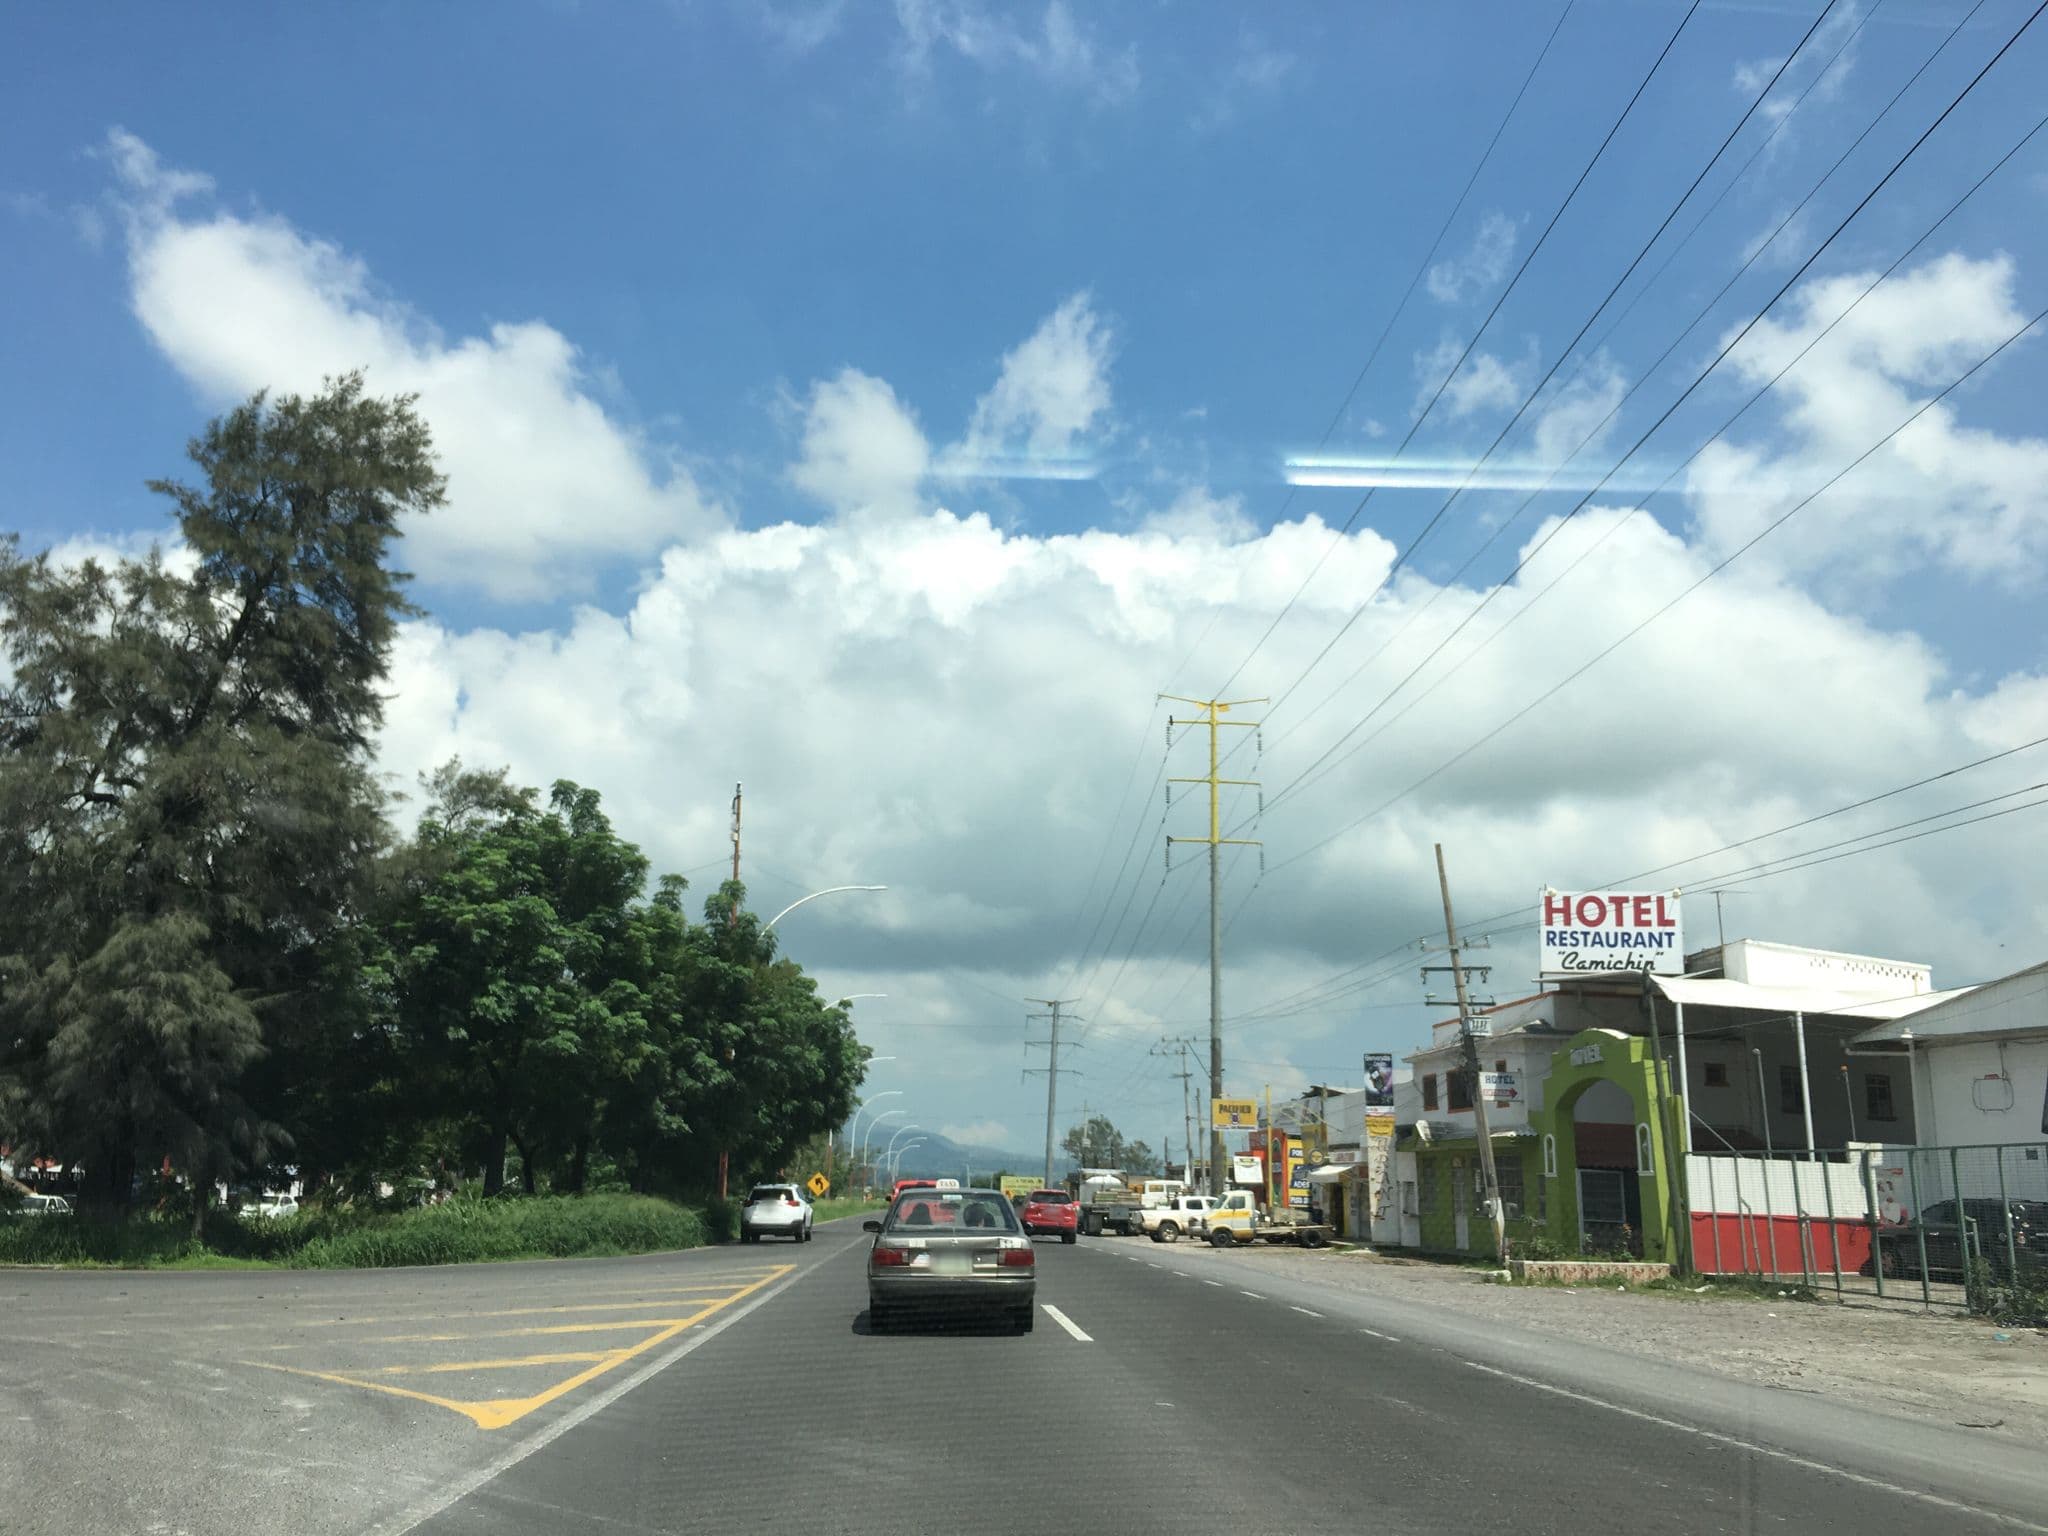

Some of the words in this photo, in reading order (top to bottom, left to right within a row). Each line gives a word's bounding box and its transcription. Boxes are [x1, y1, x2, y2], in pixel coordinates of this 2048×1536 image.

[1544, 895, 1675, 927] HOTEL
[1546, 930, 1675, 948] RESTAURANT
[1485, 1075, 1515, 1084] HOTEL
